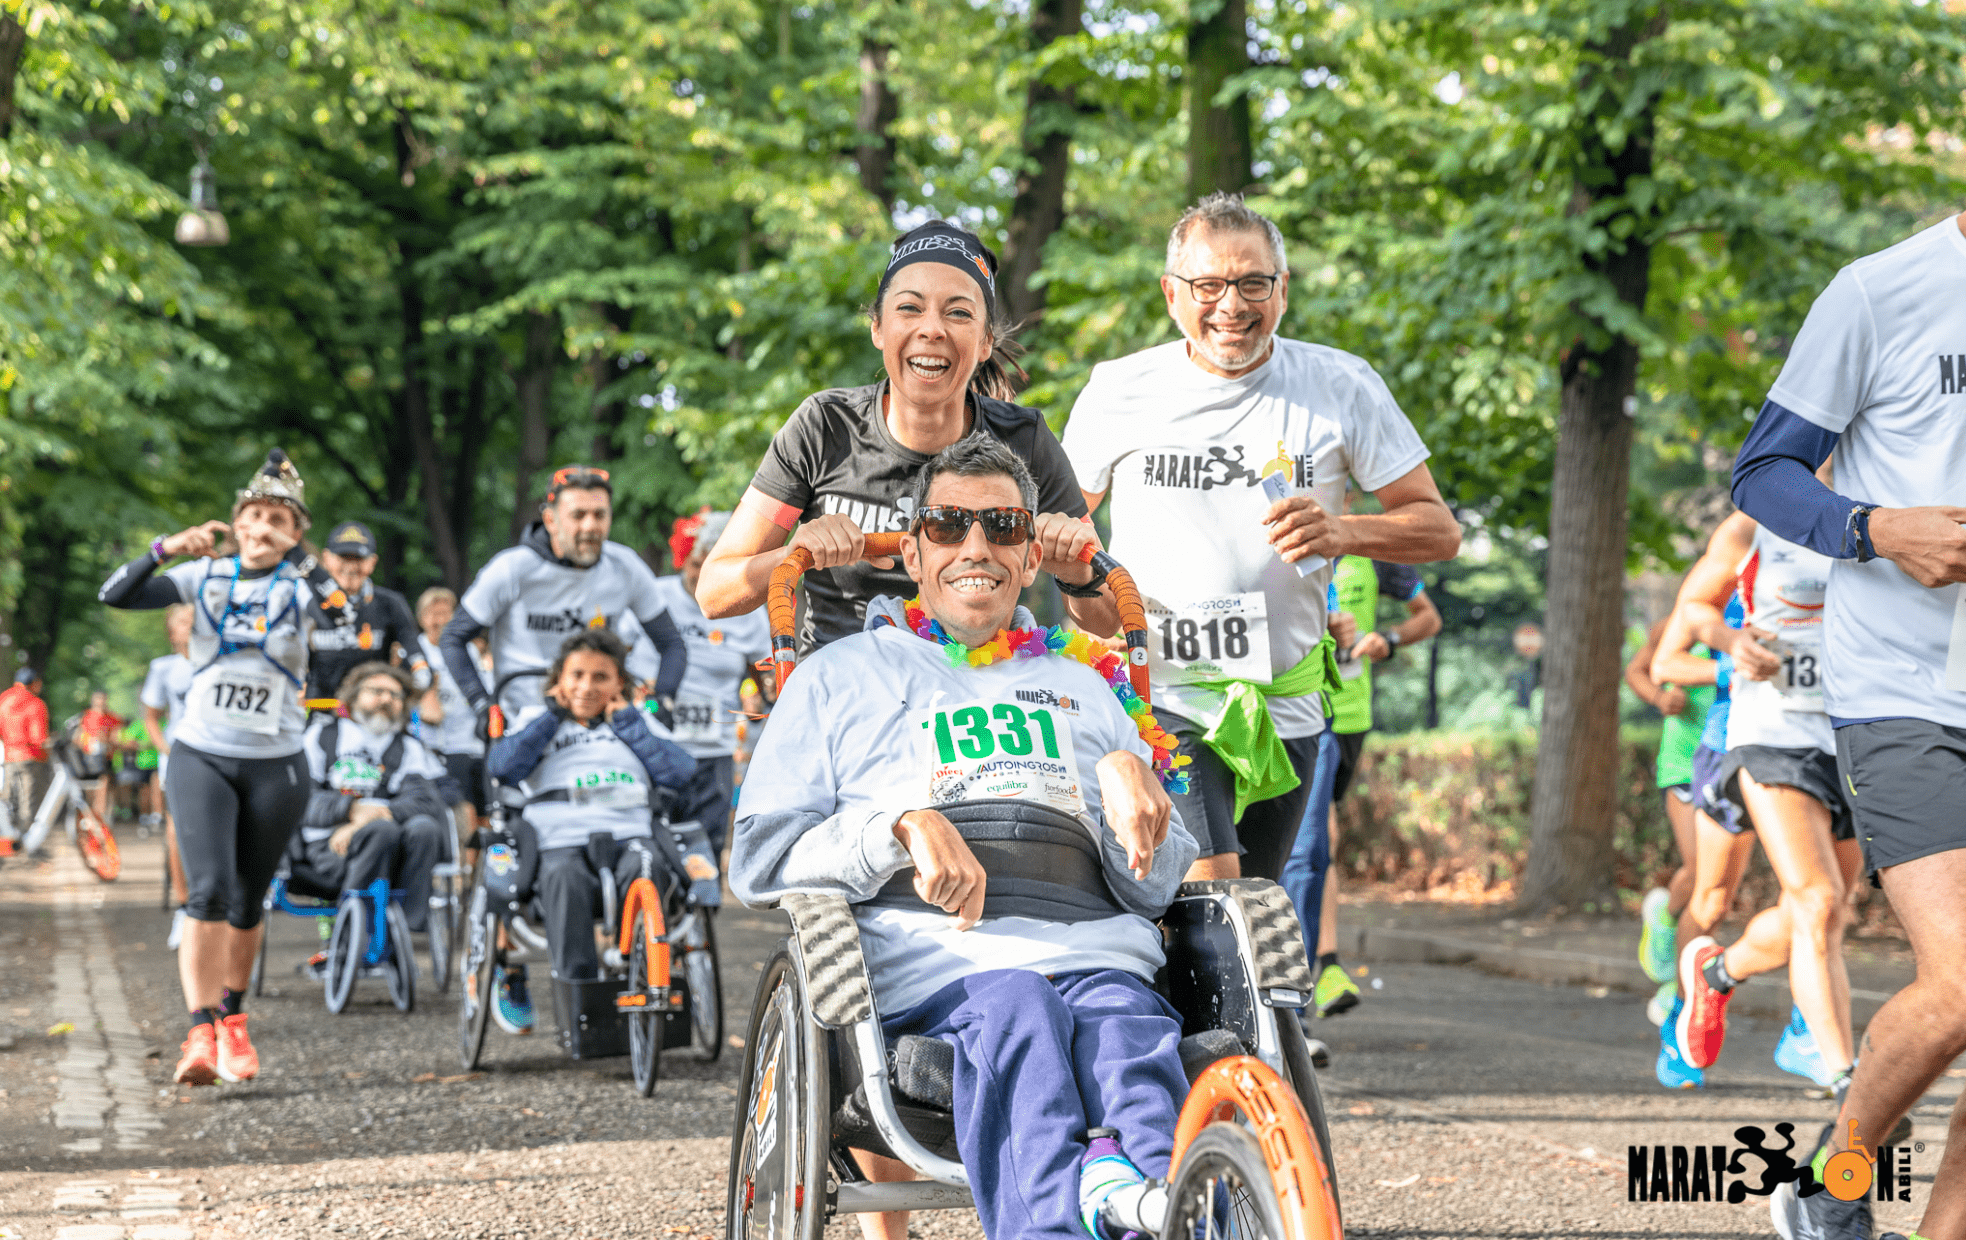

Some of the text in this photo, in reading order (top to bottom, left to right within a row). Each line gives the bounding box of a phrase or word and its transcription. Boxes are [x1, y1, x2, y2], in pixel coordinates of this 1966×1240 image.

[1158, 617, 1249, 661] 1818
[1137, 652, 1143, 660] 2
[1783, 655, 1822, 687] 13
[214, 684, 269, 714] 1732
[922, 703, 1060, 764] 1331
[987, 780, 1028, 792] equilibra
